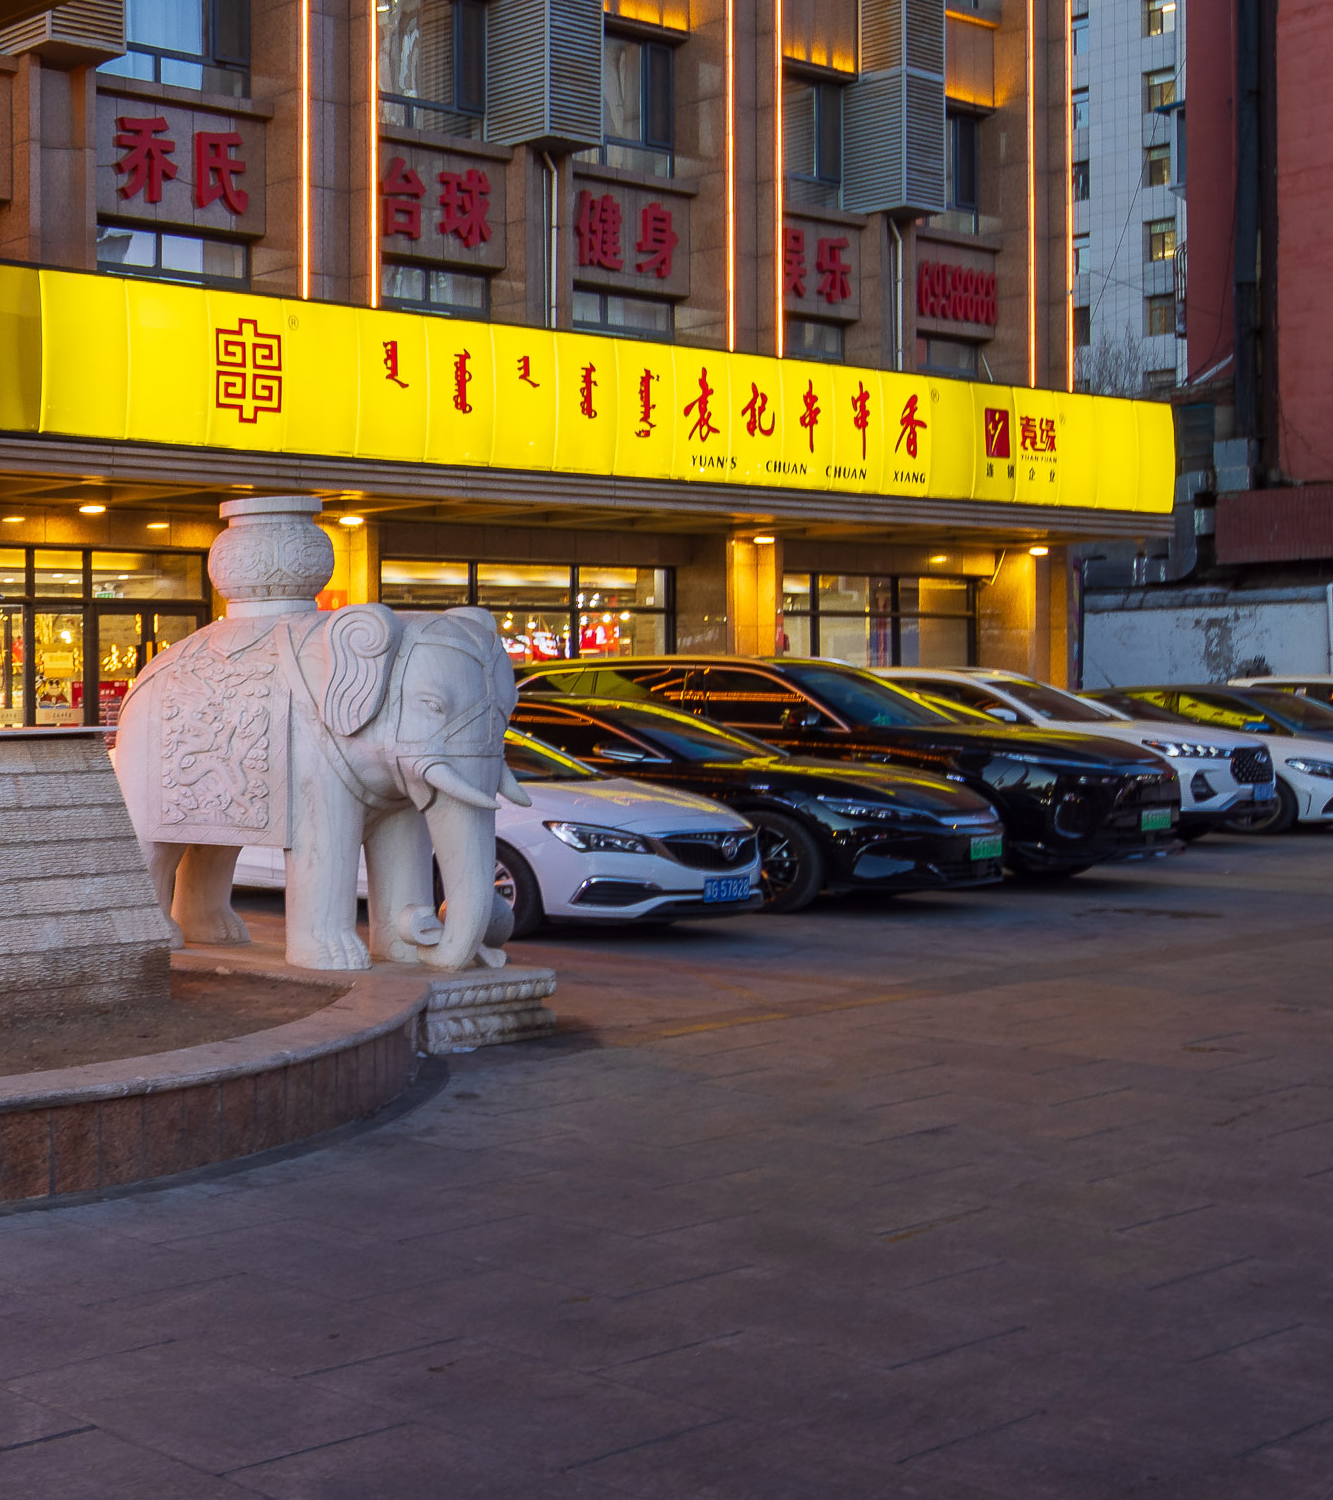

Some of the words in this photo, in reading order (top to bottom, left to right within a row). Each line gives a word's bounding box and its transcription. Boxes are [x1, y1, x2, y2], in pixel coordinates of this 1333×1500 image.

[113, 116, 249, 214] 乔氏
[379, 156, 492, 248] 台球
[575, 190, 679, 279] 健身
[683, 367, 928, 460] 袁记串串香
[691, 454, 738, 470] YUAN'S
[765, 460, 808, 476] CHUAN
[825, 464, 868, 480] CHUAN
[892, 470, 926, 484] XIANG
